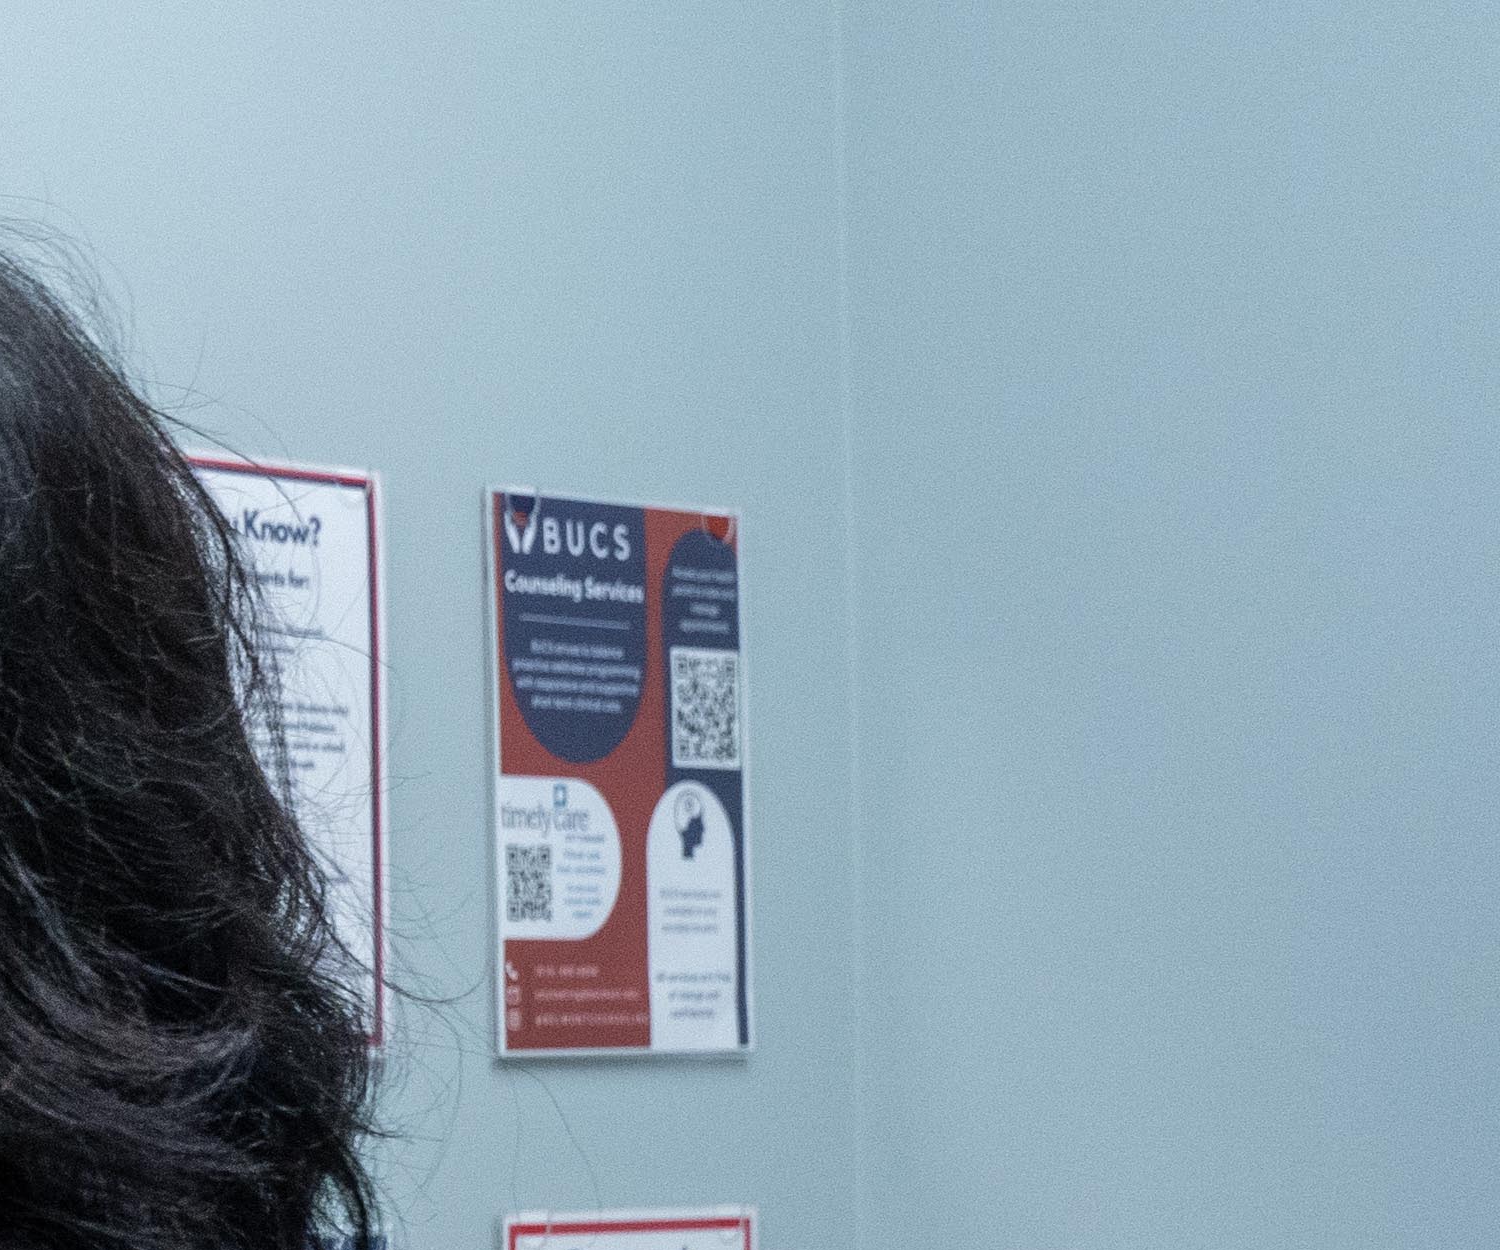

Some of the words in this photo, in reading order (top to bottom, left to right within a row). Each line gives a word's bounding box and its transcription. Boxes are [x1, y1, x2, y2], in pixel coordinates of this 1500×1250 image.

[243, 509, 322, 547] Know?
[543, 516, 632, 562] BUCS
[504, 568, 583, 603] Counseling
[583, 575, 645, 604] Services
